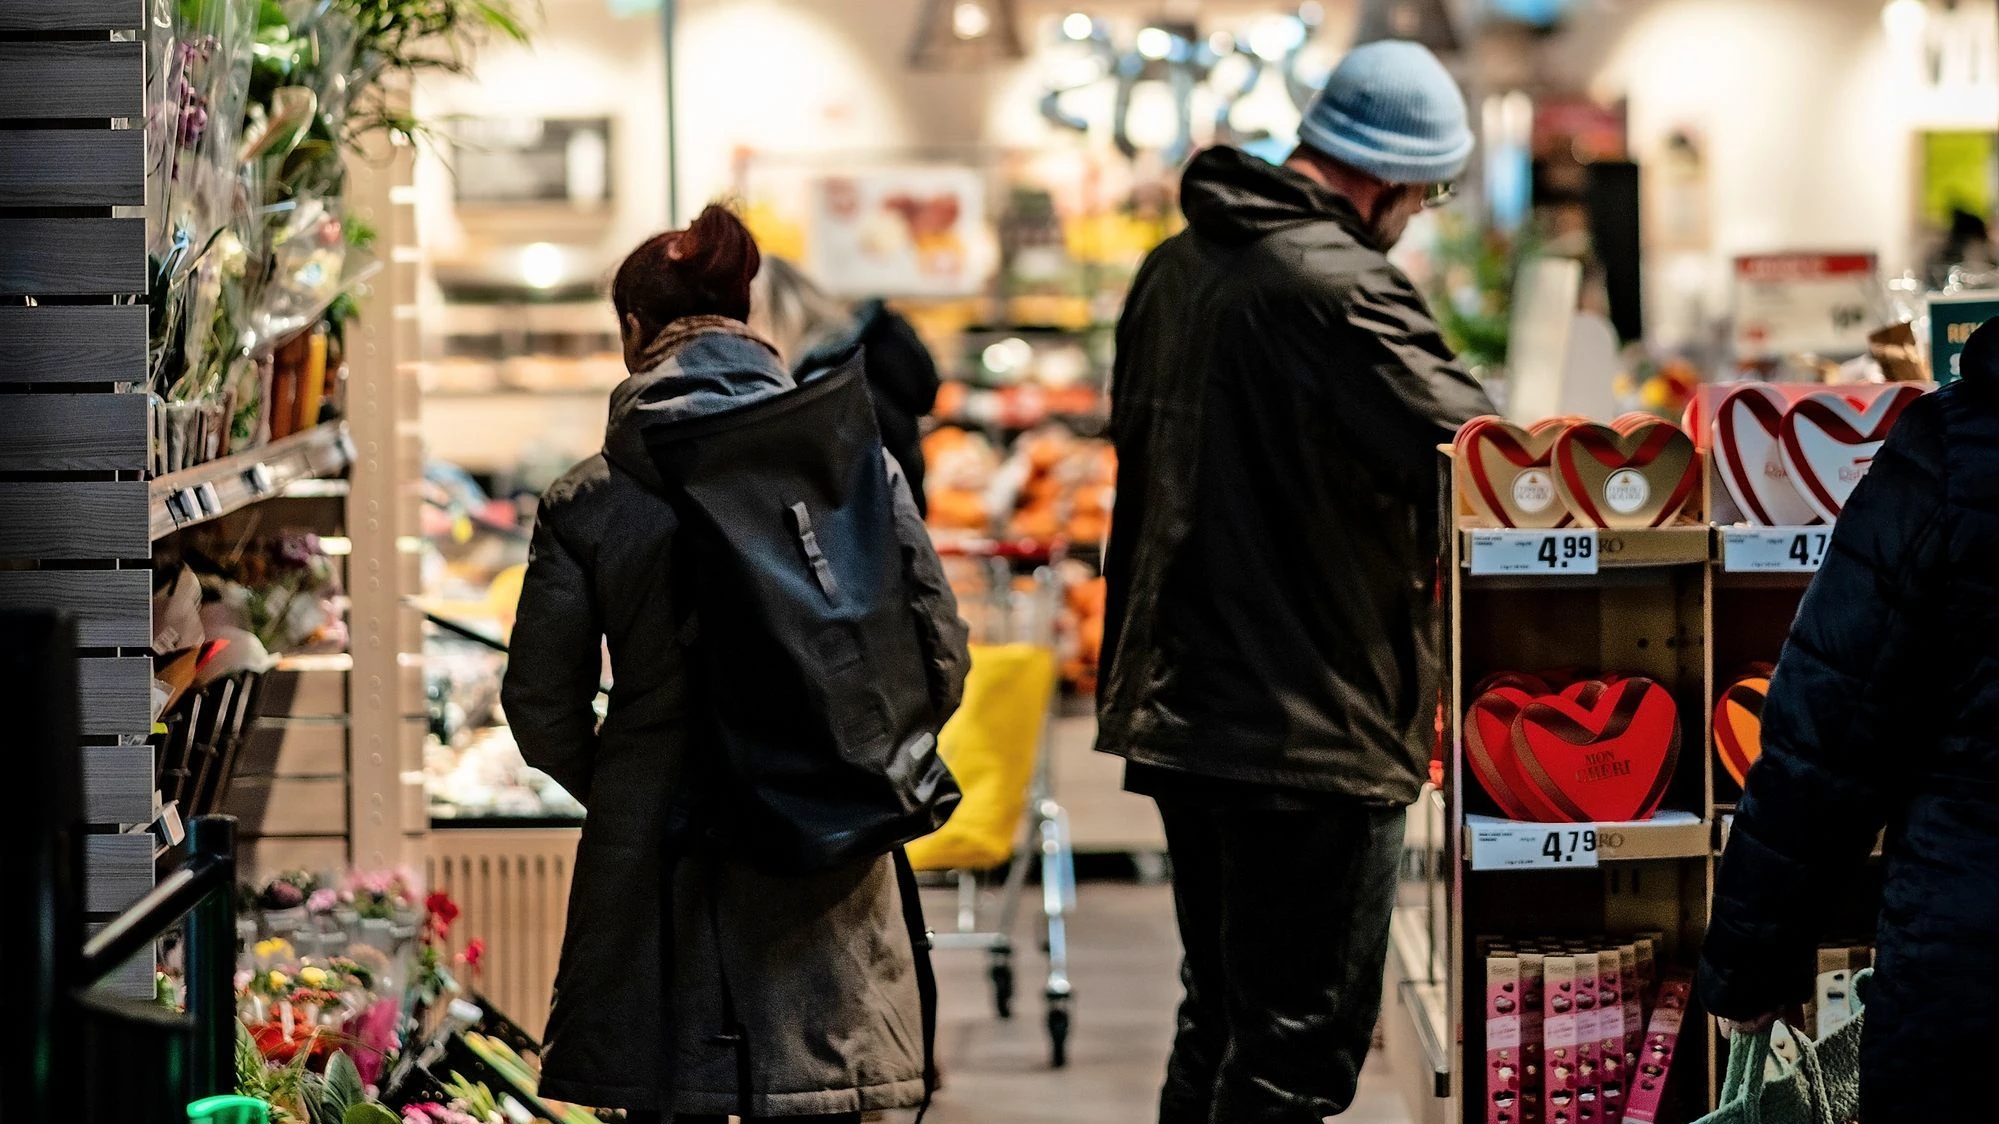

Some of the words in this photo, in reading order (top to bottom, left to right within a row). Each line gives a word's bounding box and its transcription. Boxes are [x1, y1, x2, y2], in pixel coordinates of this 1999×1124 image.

[1538, 536, 1592, 568] 4.99
[1585, 750, 1615, 765] MON
[1542, 830, 1597, 862] 4.79
